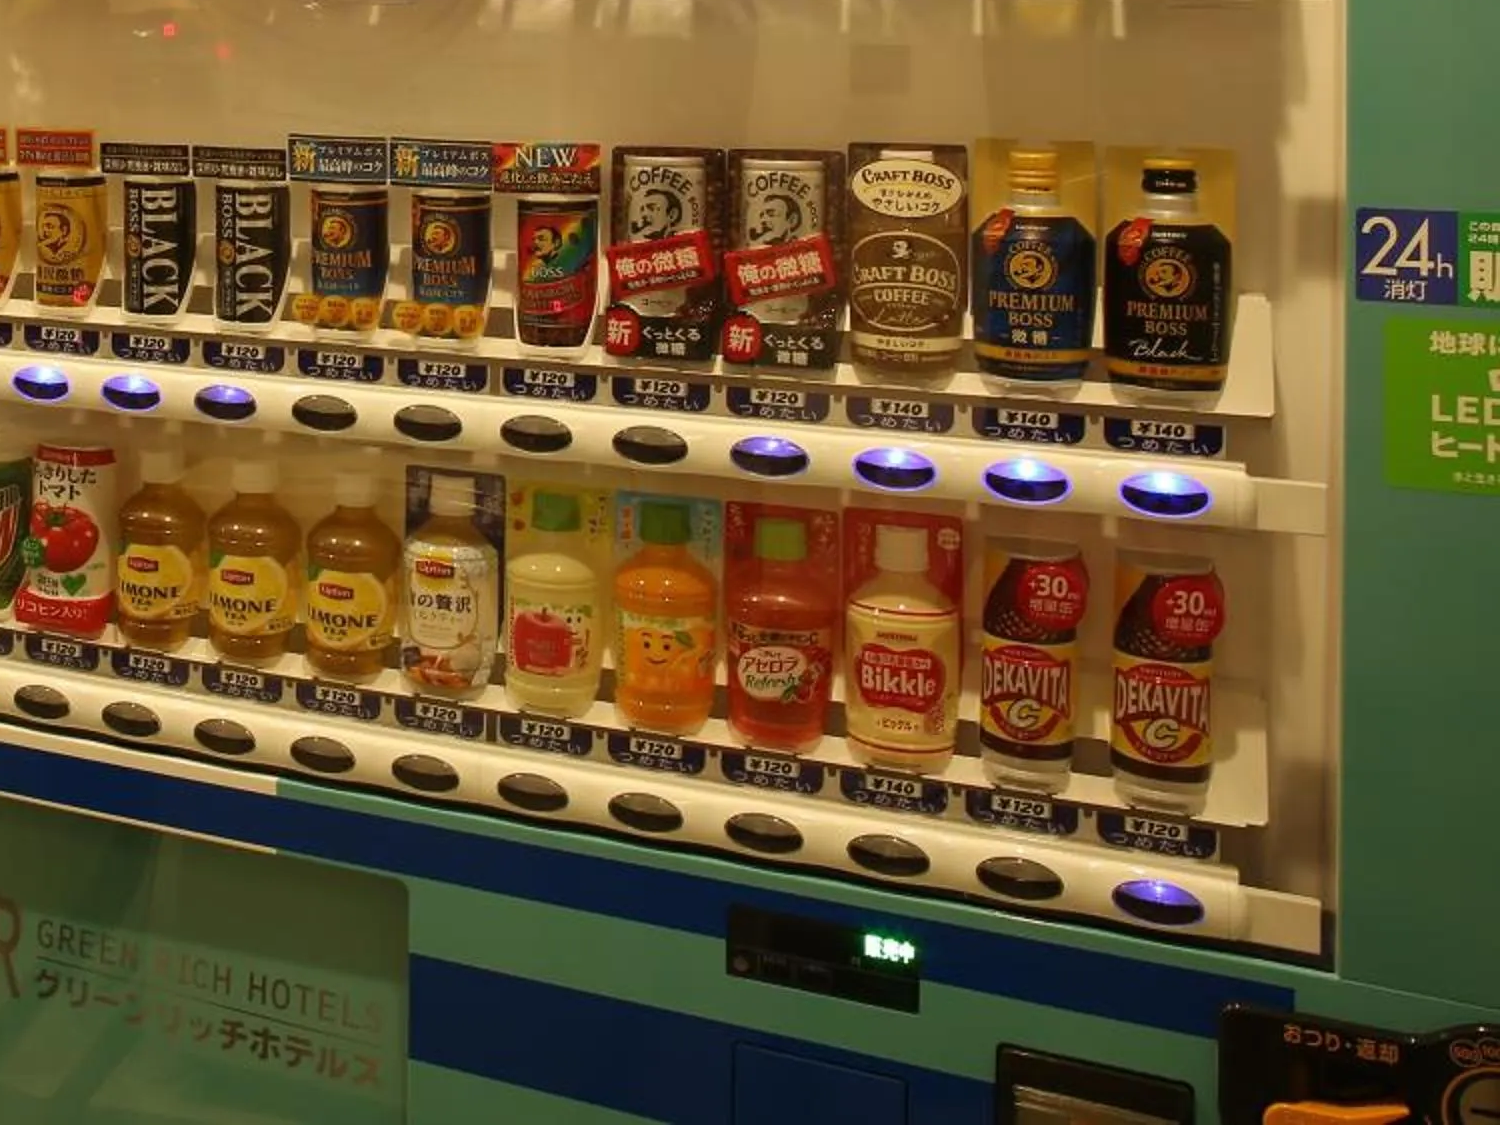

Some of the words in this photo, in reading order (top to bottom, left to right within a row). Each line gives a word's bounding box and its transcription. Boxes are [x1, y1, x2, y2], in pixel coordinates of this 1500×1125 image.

[514, 146, 578, 168] NEW
[629, 166, 694, 196] COFFEE
[748, 171, 812, 200] COFFEE
[861, 168, 910, 185] CRAFT
[912, 170, 955, 190] BOSS
[128, 188, 140, 233] BOSS
[221, 193, 233, 239] BOSS
[141, 188, 181, 312] BLACK
[235, 192, 275, 317] BLACK
[910, 265, 958, 291] BOSS
[873, 287, 931, 306] COFFEE
[1384, 279, 1429, 302] 消灯
[988, 290, 1075, 313] PREMIUM
[1008, 312, 1054, 328] BOSS
[1127, 300, 1209, 323] PREMIUM
[44, 328, 76, 341] ¥120
[607, 318, 632, 346] 新
[642, 326, 701, 342] ぐっとくる
[1145, 321, 1189, 337] BOSS
[132, 337, 167, 350] ¥120
[728, 324, 754, 353] 新
[764, 333, 825, 350] ぐっとくる
[224, 344, 260, 358] ¥120
[320, 355, 358, 367] ¥120
[424, 363, 463, 376] ¥120
[529, 372, 569, 386] ¥120
[639, 381, 682, 395] ¥120
[755, 390, 799, 404] ¥120
[880, 401, 924, 416] ¥140
[1005, 412, 1051, 427] ¥140
[1137, 422, 1187, 438] ¥140
[39, 480, 82, 501] トマト
[120, 581, 181, 600] IMONE
[409, 592, 473, 616] の贅沢
[46, 643, 78, 656] ¥120
[132, 656, 166, 671] ¥120
[742, 656, 800, 674] アセロラ
[224, 673, 259, 687] ¥120
[861, 664, 937, 698] Bikkle
[983, 657, 1069, 713] DEKAVITA
[318, 688, 356, 704] ¥120
[1114, 674, 1210, 735] DEKAVITA
[418, 705, 458, 722] ¥120
[524, 723, 565, 738] ¥120
[633, 741, 676, 756] ¥120
[750, 758, 793, 774] ¥120
[871, 778, 916, 795] ¥140
[996, 799, 1046, 817] ¥120
[1132, 819, 1182, 838] ¥120
[37, 918, 140, 970] GREEN
[247, 970, 385, 1034] HOTELS
